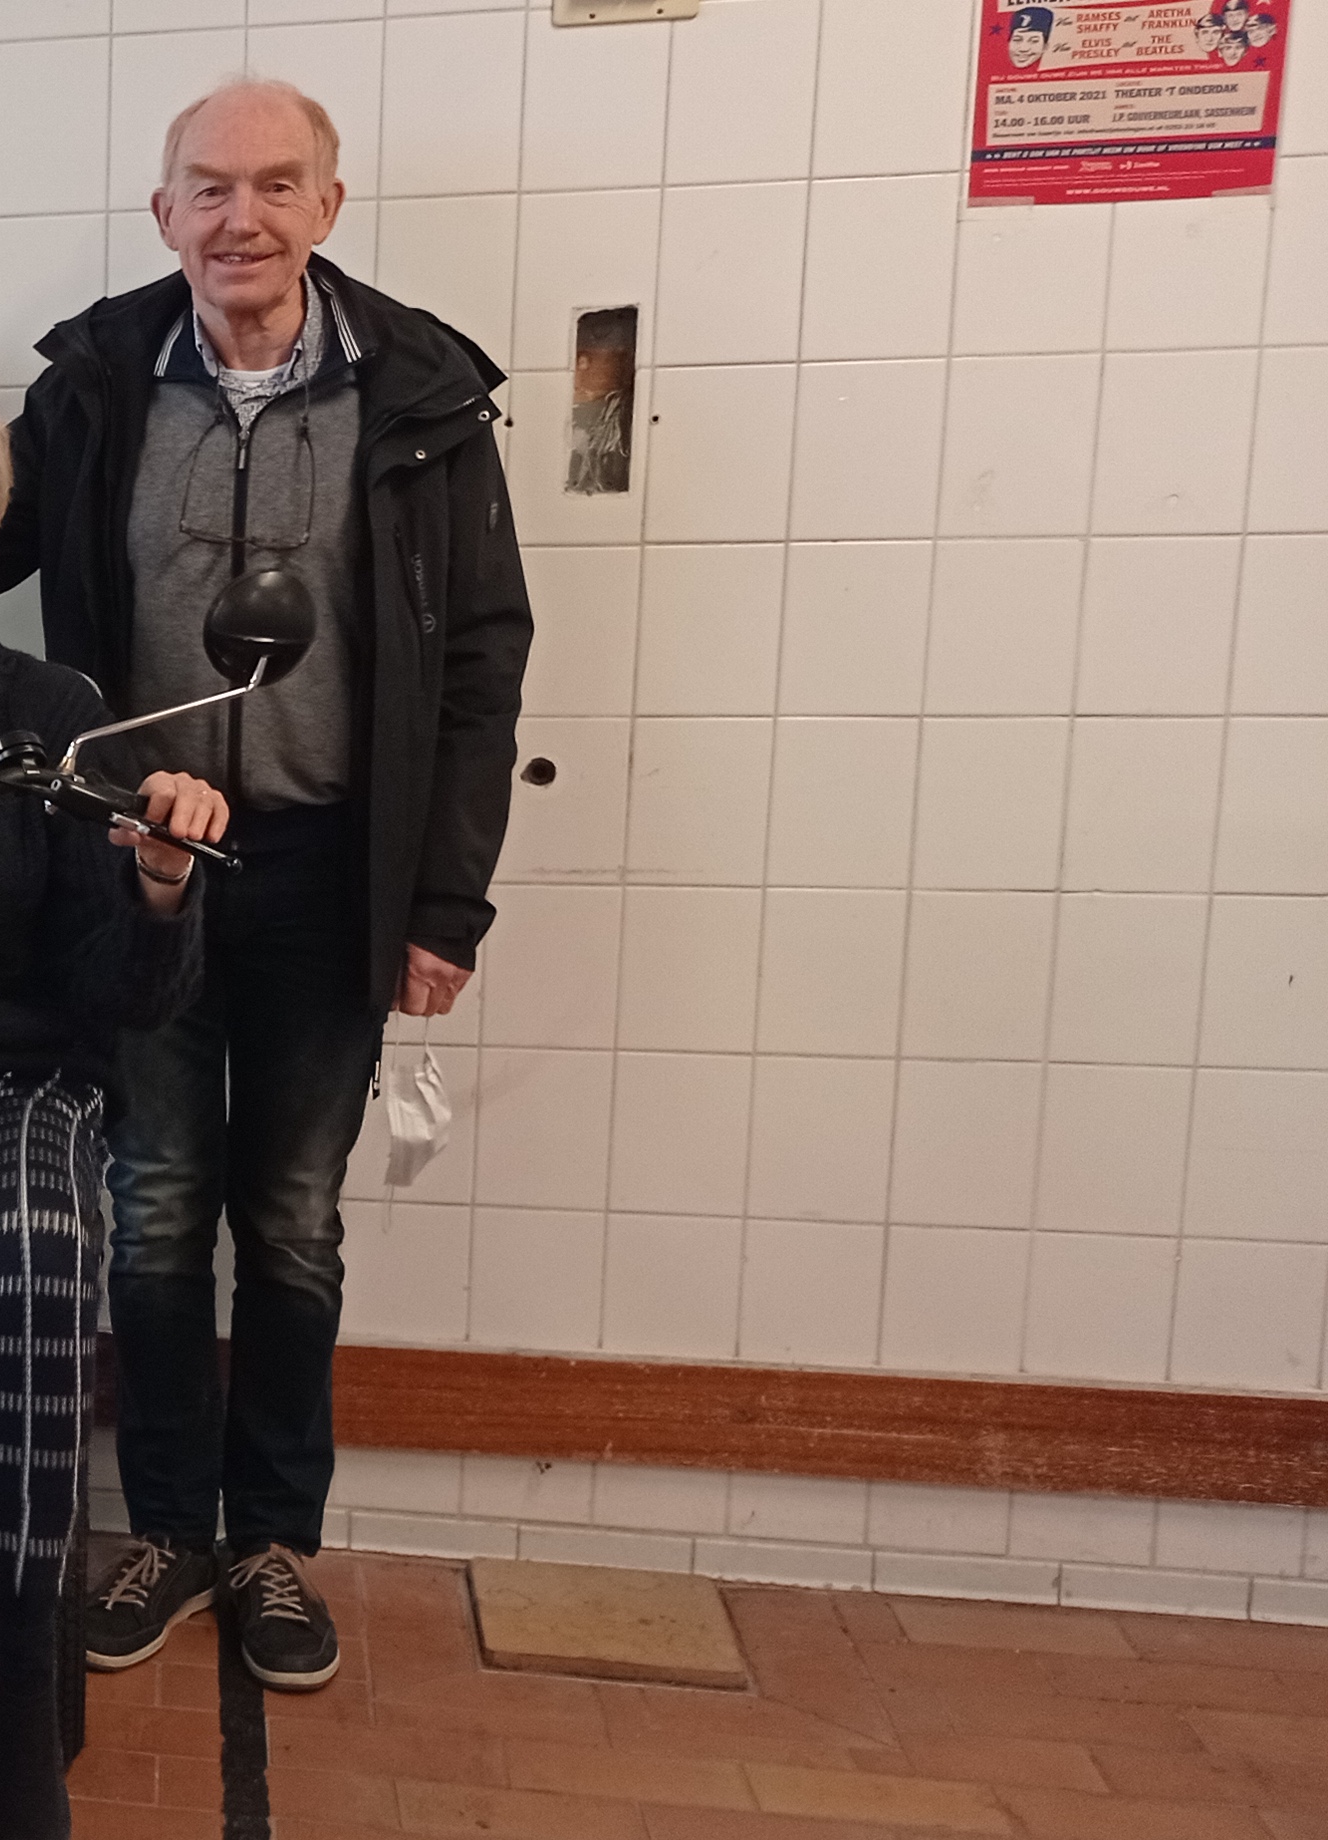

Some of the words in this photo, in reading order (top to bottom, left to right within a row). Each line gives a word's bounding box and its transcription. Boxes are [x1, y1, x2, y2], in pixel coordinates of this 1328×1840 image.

[1076, 11, 1122, 22] RAMSES
[1148, 8, 1191, 19] ARETHA
[1076, 23, 1120, 34] SHAFFY
[1141, 19, 1197, 30] FRANKLIN
[1081, 38, 1112, 48] ELVIS
[1151, 34, 1172, 44] THE
[1071, 48, 1120, 60] PRESLEY
[1136, 45, 1184, 56] BEATLES
[1017, 94, 1025, 103] 4
[1027, 92, 1077, 103] OKTOBER
[1079, 90, 1107, 100] 2021
[1114, 87, 1163, 99] THEATER
[1178, 84, 1239, 95] ONDERDAK
[994, 118, 1024, 128] 14.00
[1033, 116, 1064, 127] 16.00
[1067, 114, 1091, 124] UUR
